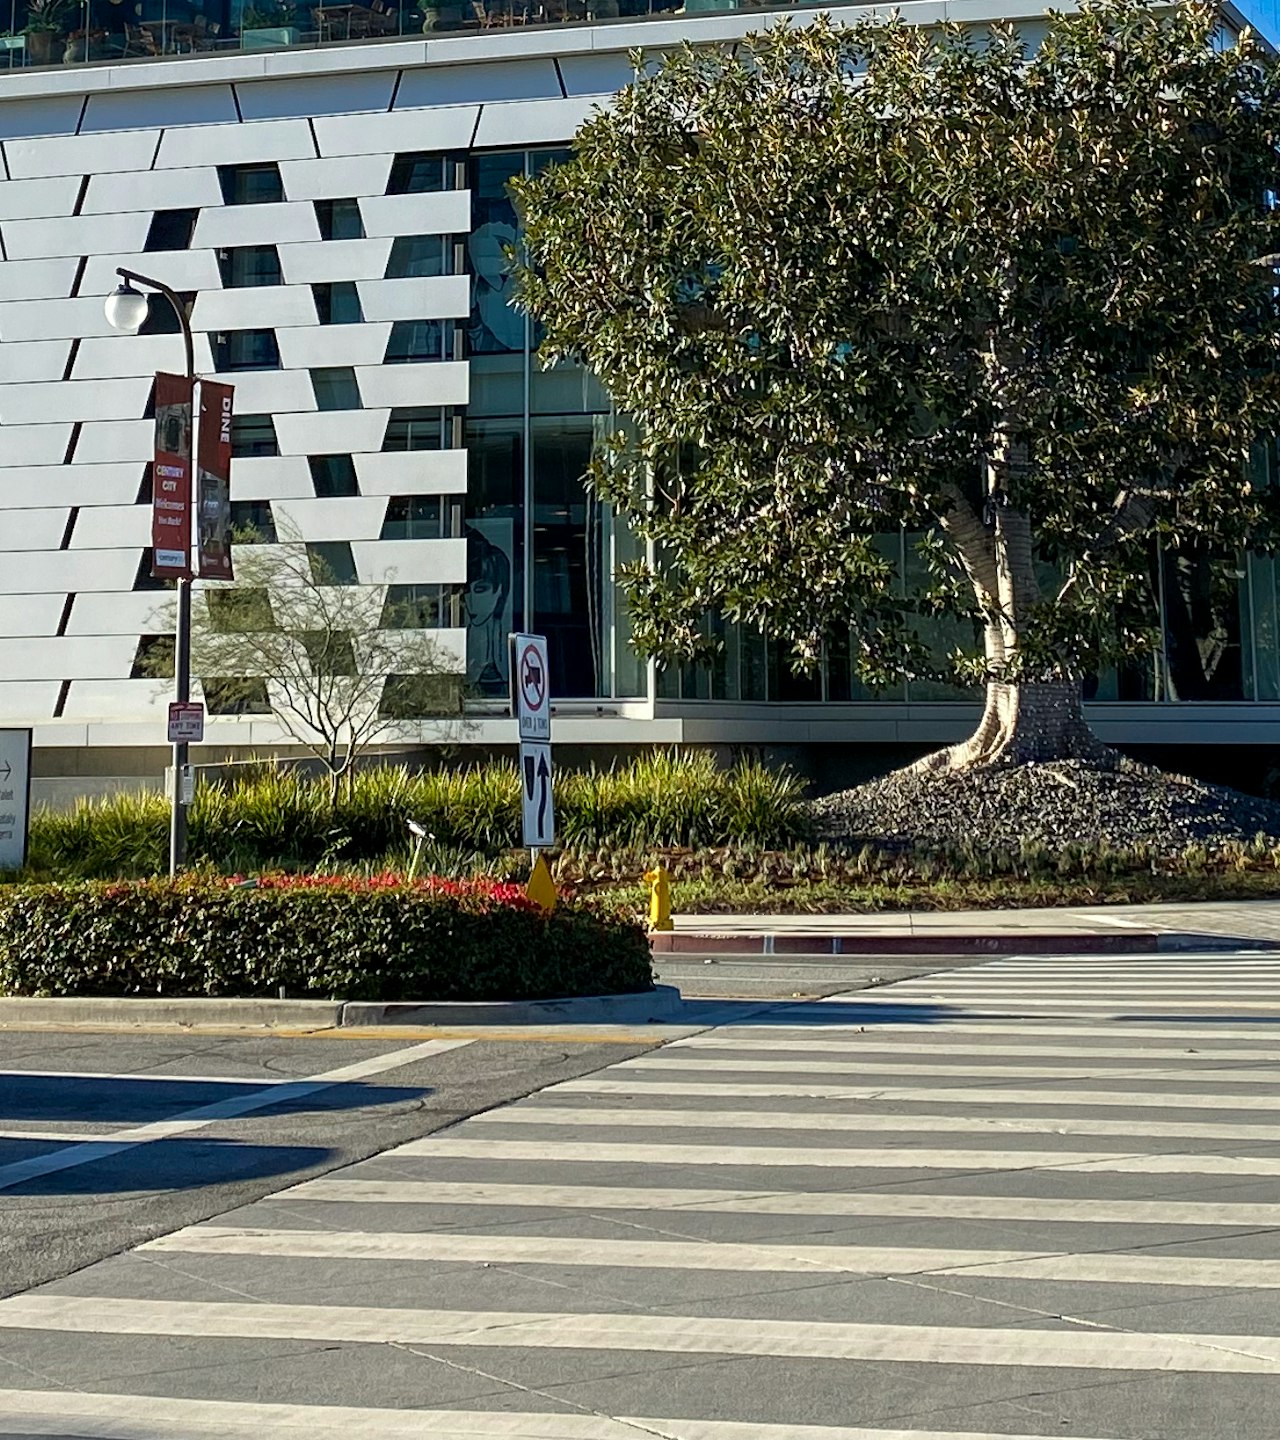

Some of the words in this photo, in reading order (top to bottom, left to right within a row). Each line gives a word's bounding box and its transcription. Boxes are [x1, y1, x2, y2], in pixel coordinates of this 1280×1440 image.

[221, 397, 232, 444] DINE
[156, 465, 185, 479] CENTURY
[162, 481, 178, 492] CITY
[171, 721, 184, 730] ANY
[186, 722, 201, 730] TIME
